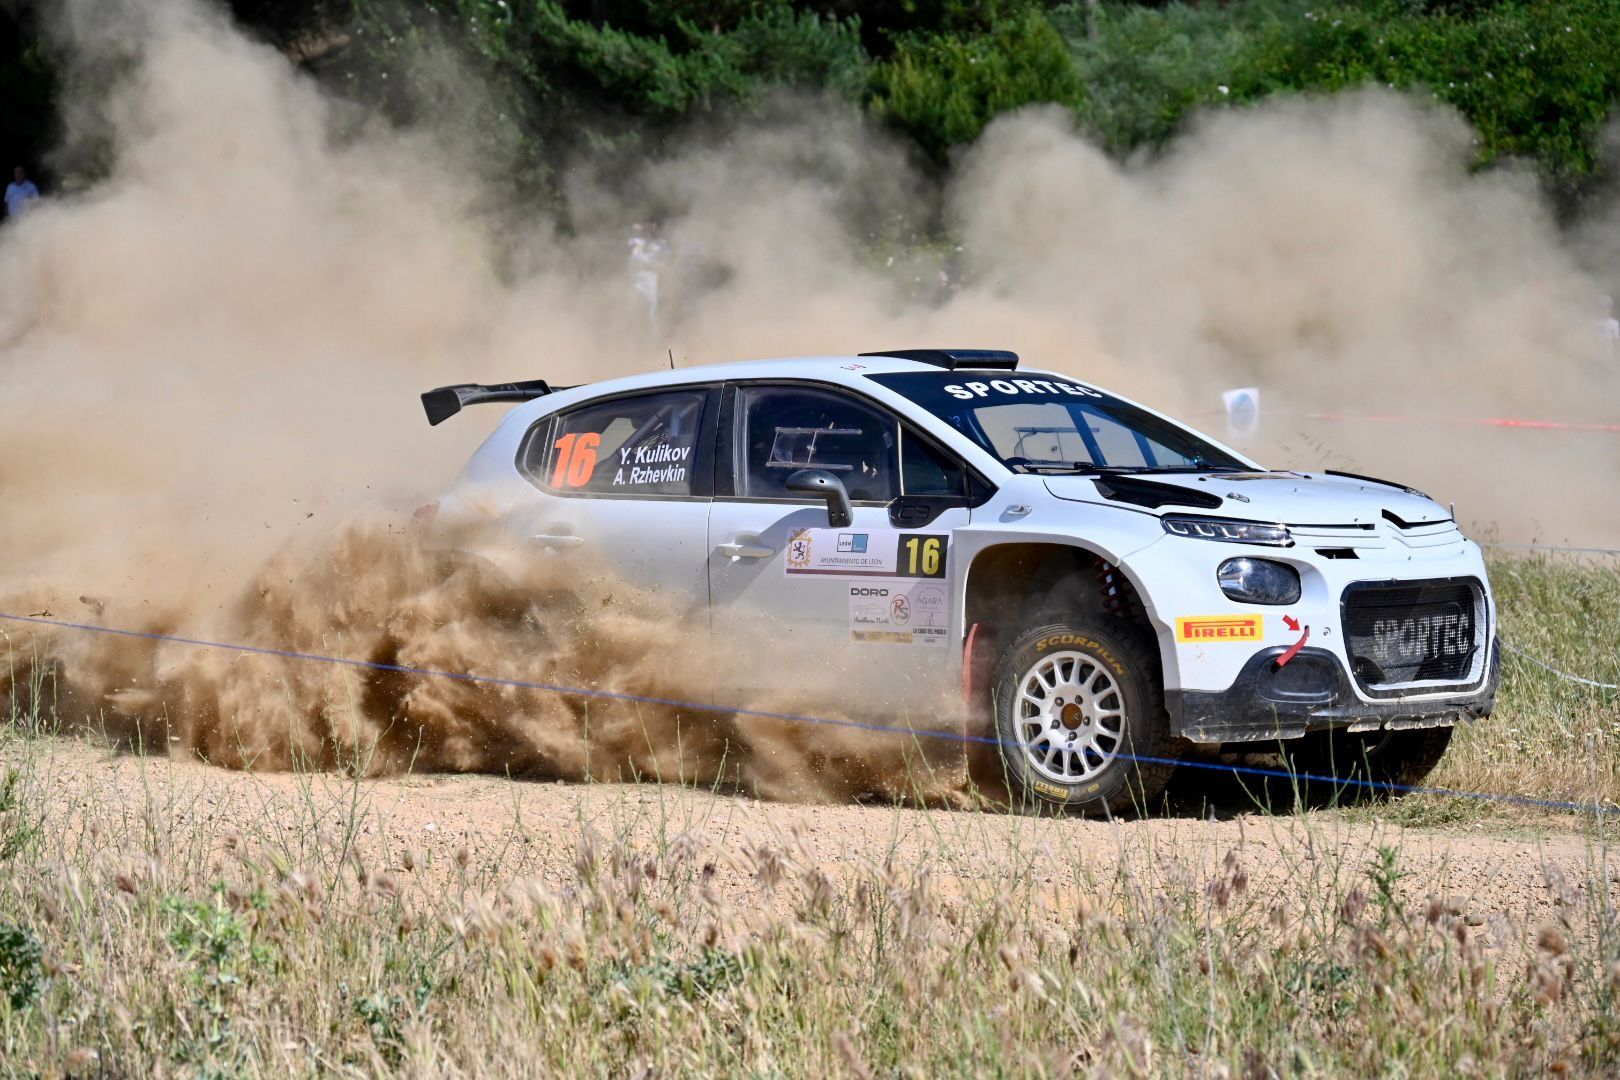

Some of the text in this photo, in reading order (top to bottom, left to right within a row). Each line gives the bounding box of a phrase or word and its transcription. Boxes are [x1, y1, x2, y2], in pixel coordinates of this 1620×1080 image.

[944, 379, 1103, 400] SPORTEC
[553, 432, 600, 489] 16
[619, 444, 691, 465] Y. Kulikov
[613, 464, 686, 486] A. Rzhevkin
[906, 537, 940, 575] 16
[850, 588, 889, 597] DORO
[1183, 618, 1256, 639] PIRELLI
[1373, 613, 1470, 658] SPORTEC
[1035, 634, 1126, 678] SCORPION
